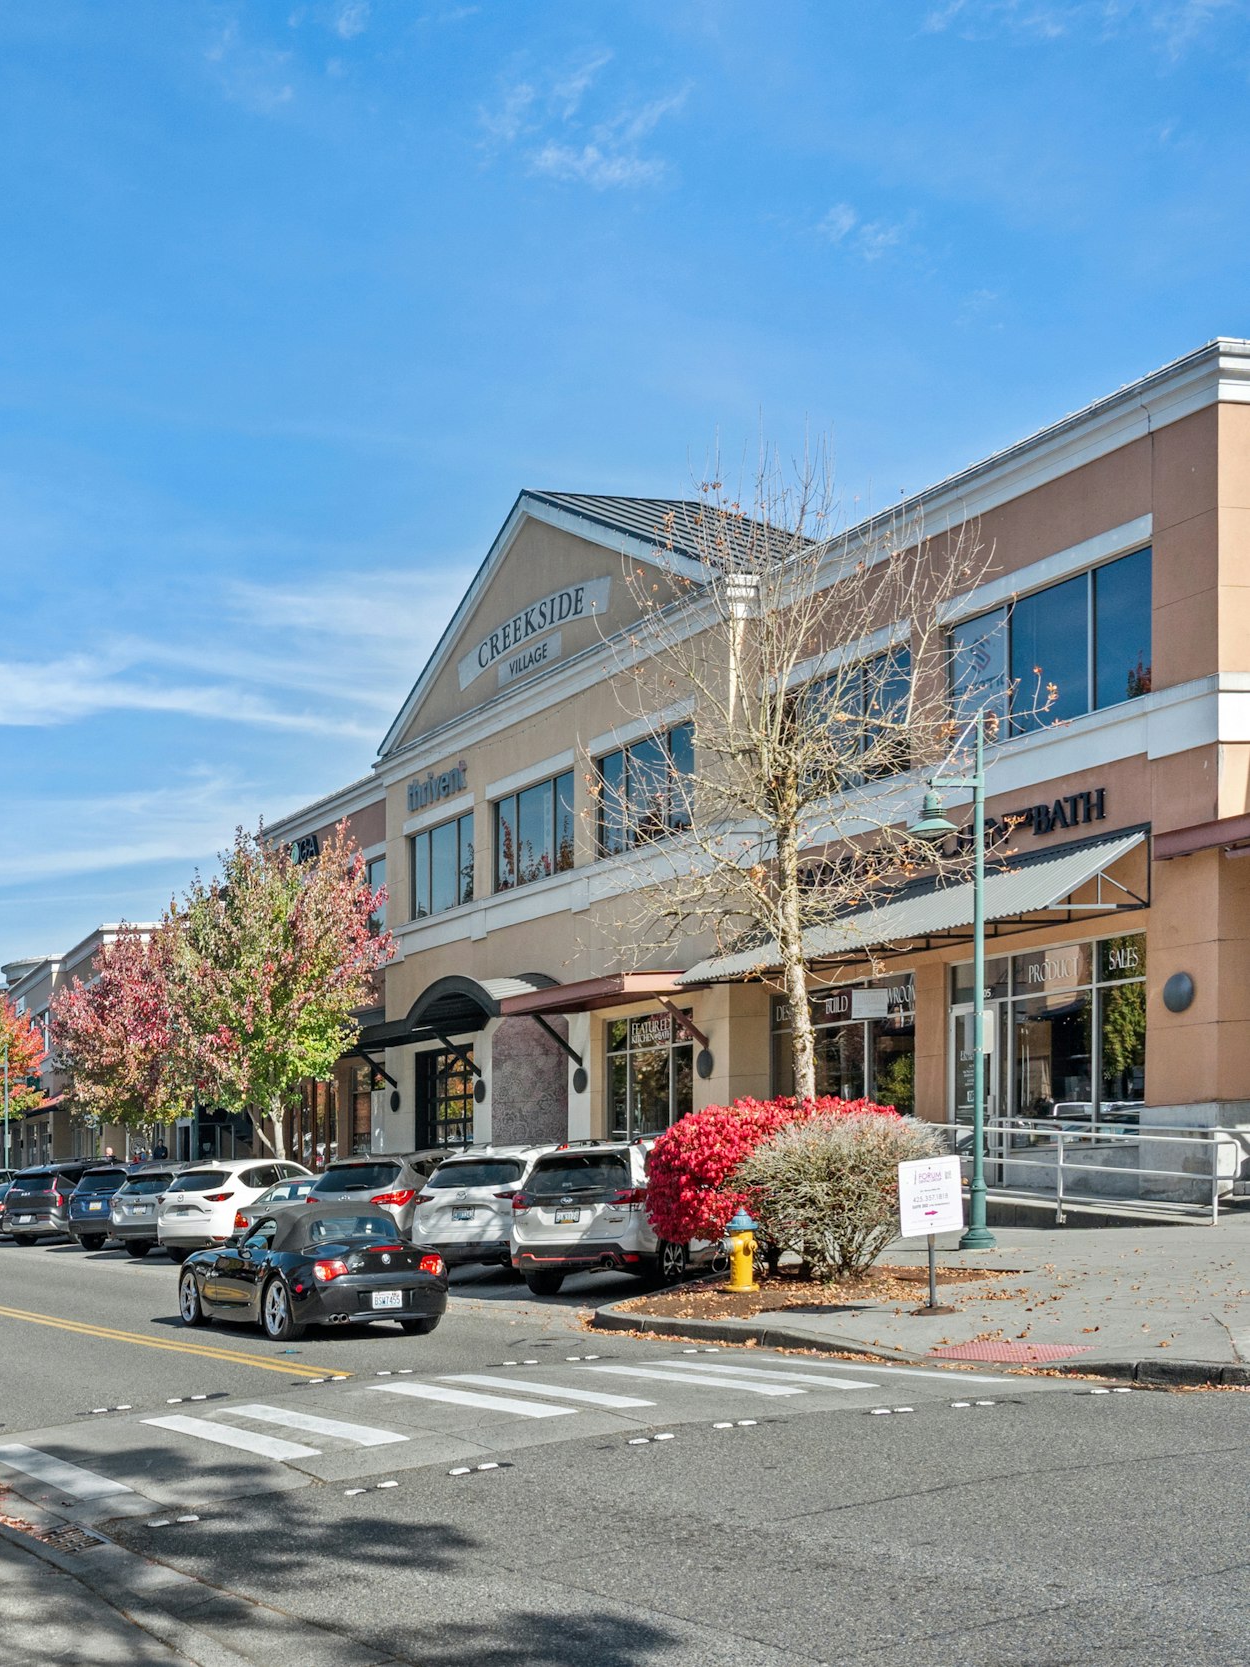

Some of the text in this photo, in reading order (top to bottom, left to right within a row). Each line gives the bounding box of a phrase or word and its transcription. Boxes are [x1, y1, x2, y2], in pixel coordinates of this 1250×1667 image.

[478, 587, 584, 668] CREEKSIDE
[509, 643, 548, 677] VILLAGE
[407, 760, 468, 812] thrivent
[1033, 788, 1107, 836] BATH
[1028, 956, 1079, 984] PRODUCT
[1108, 947, 1139, 971] SALES
[825, 995, 849, 1015] BUILD
[631, 1017, 671, 1036] FEATURED
[918, 1171, 942, 1181] FORUM
